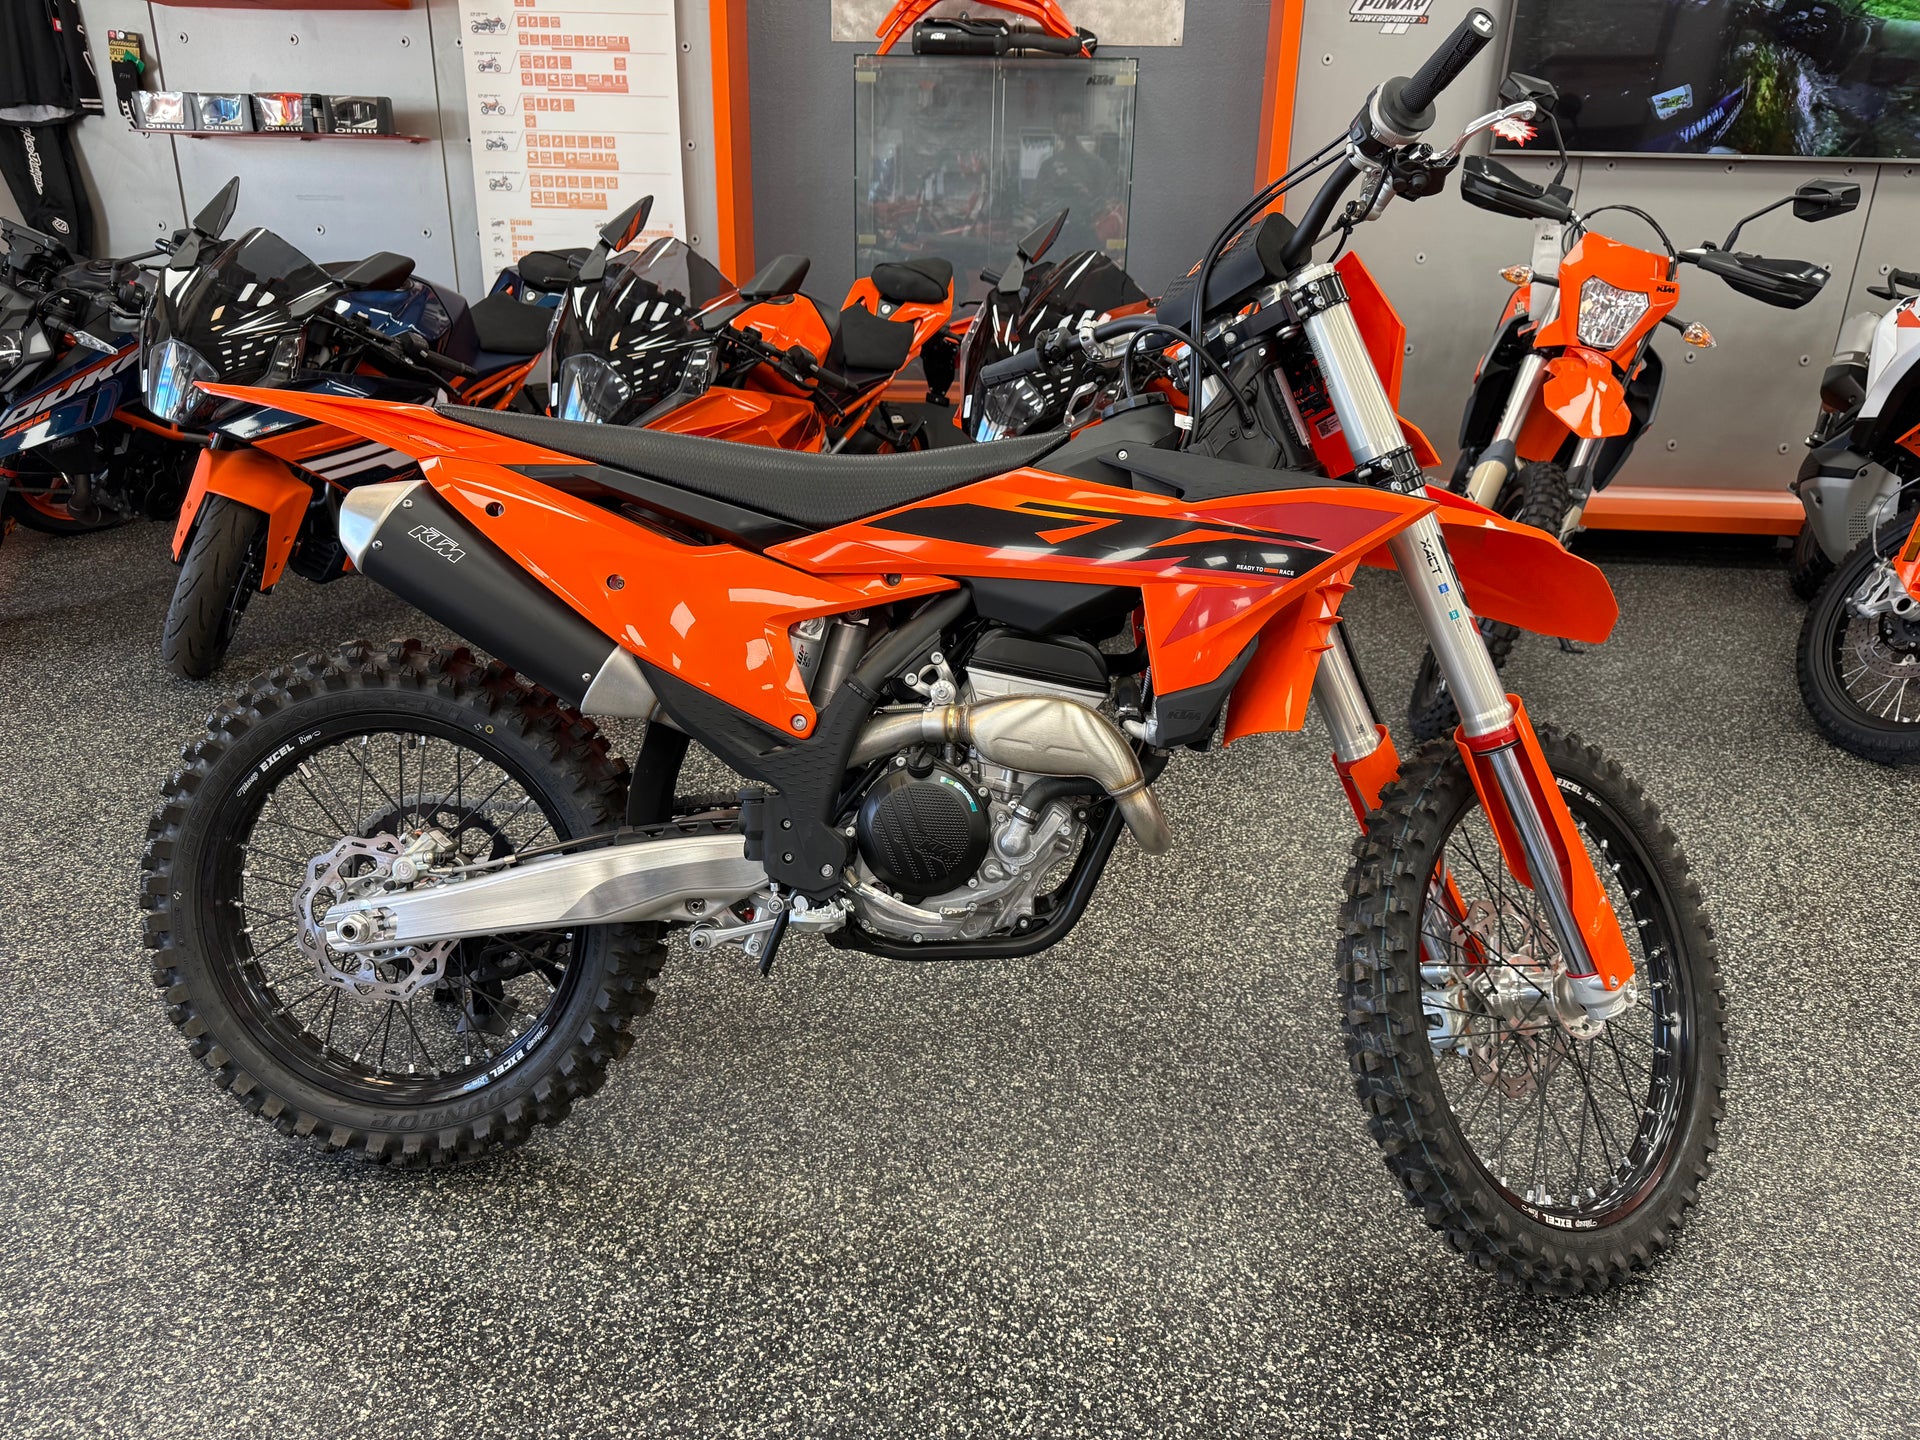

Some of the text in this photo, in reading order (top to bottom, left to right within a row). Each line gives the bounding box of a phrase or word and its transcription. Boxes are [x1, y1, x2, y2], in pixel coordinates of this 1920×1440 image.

[1351, 14, 1418, 23] POWERSPORTS
[930, 33, 946, 41] KTM
[1679, 106, 1725, 143] YAMAHA
[1656, 285, 1676, 294] KTM
[407, 524, 466, 564] KTM
[1419, 537, 1443, 575] XACT
[1236, 564, 1255, 572] READY
[259, 743, 295, 773] EXCEL
[298, 730, 322, 745] Rim
[1555, 777, 1583, 796] EXCEL
[489, 1049, 525, 1078] EXCEL
[1543, 1214, 1573, 1228] EXCEL
